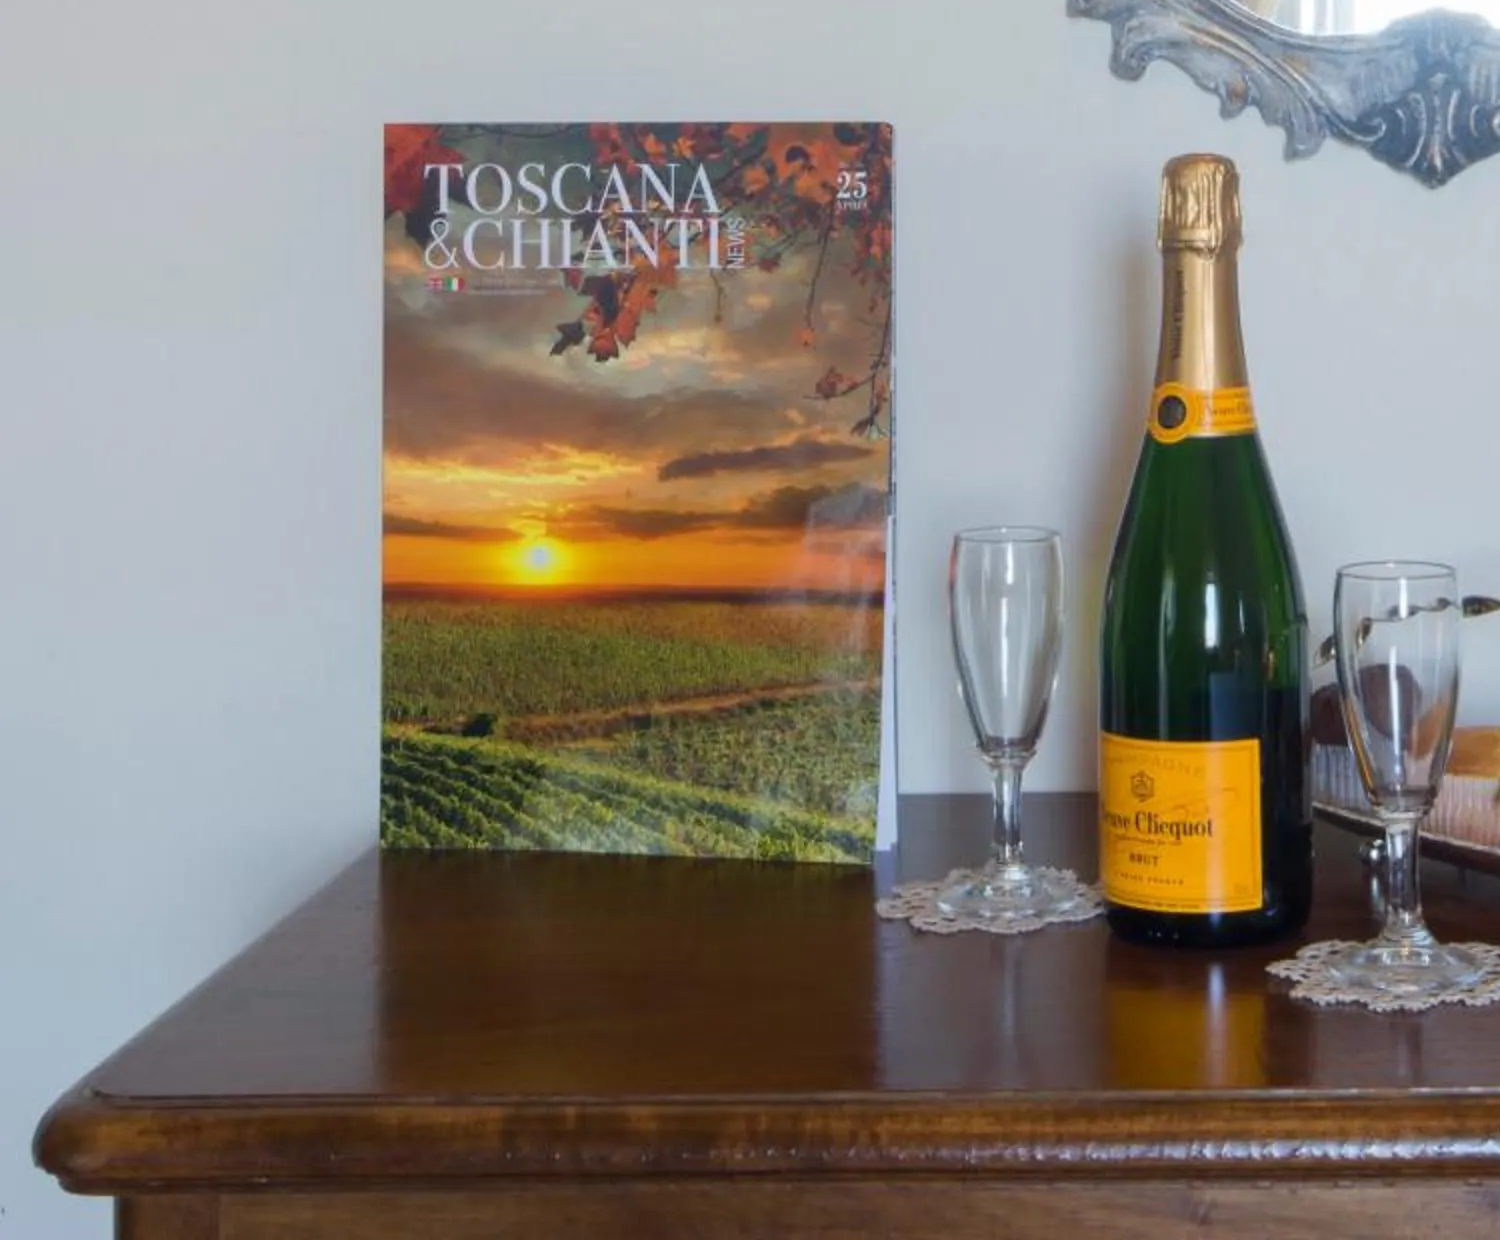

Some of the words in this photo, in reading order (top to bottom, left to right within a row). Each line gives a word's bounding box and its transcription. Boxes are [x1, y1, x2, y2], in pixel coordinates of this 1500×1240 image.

[424, 162, 722, 214] TOSCANA
[836, 171, 867, 199] 25
[727, 216, 746, 270] NEWS
[1134, 810, 1214, 841] Clicquot
